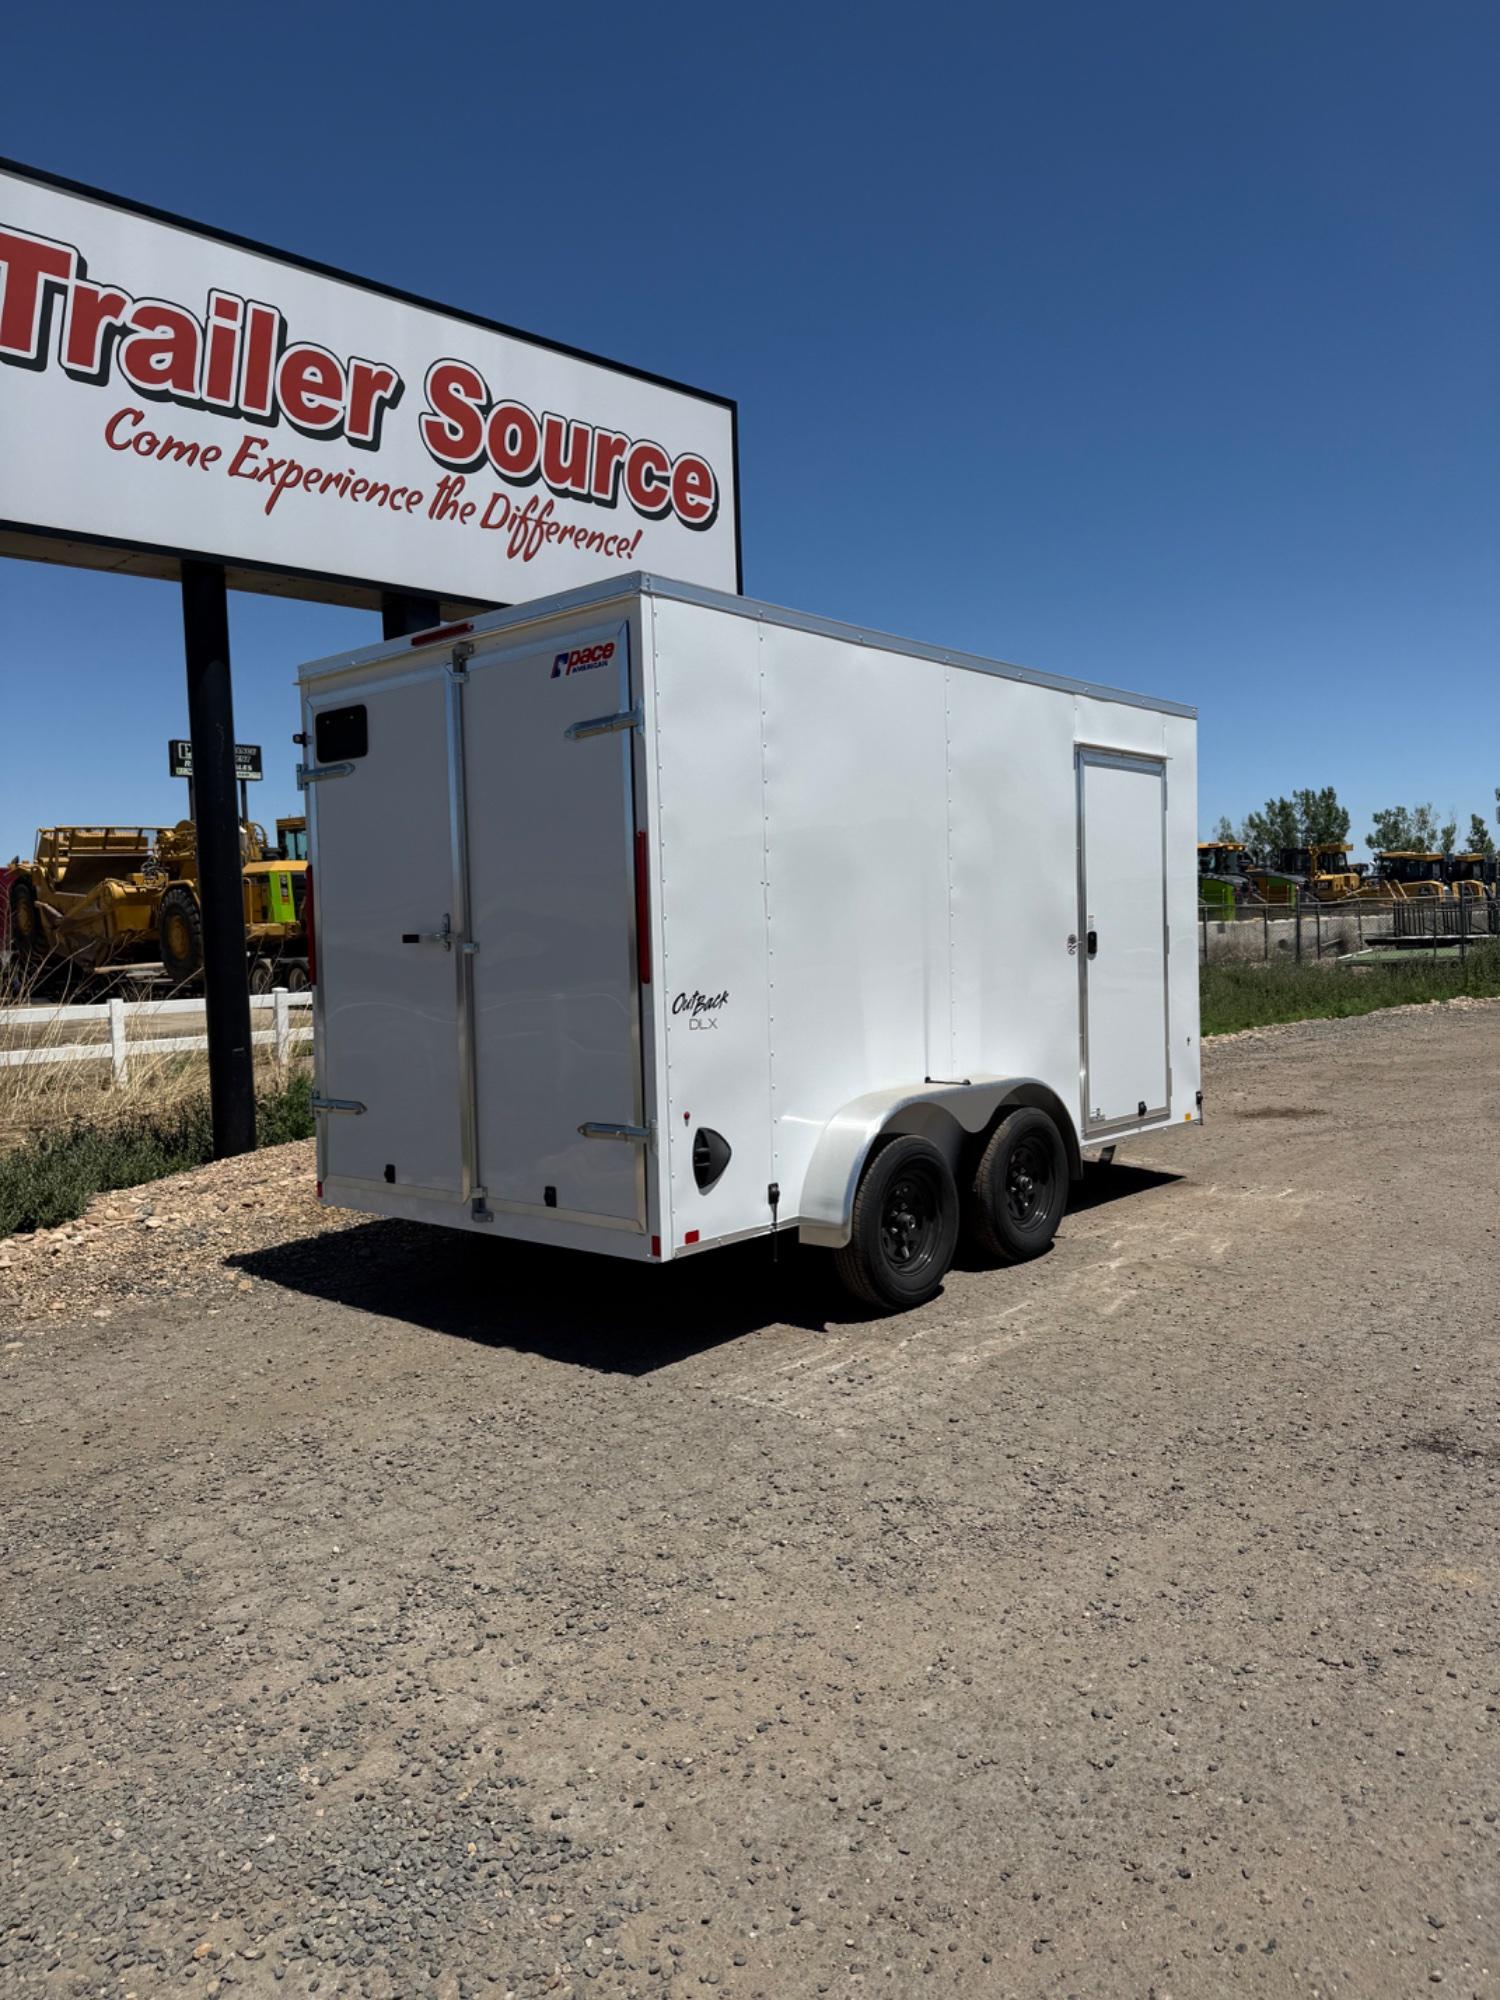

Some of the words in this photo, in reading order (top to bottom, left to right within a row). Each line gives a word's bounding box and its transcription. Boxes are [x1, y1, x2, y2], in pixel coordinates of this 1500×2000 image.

[0, 224, 405, 452] Trailer
[419, 358, 720, 532] Source
[104, 407, 222, 471] Come
[228, 435, 424, 516] Experience
[428, 475, 477, 525] the
[480, 492, 643, 562] Difference!
[689, 1018, 718, 1031] DLX
